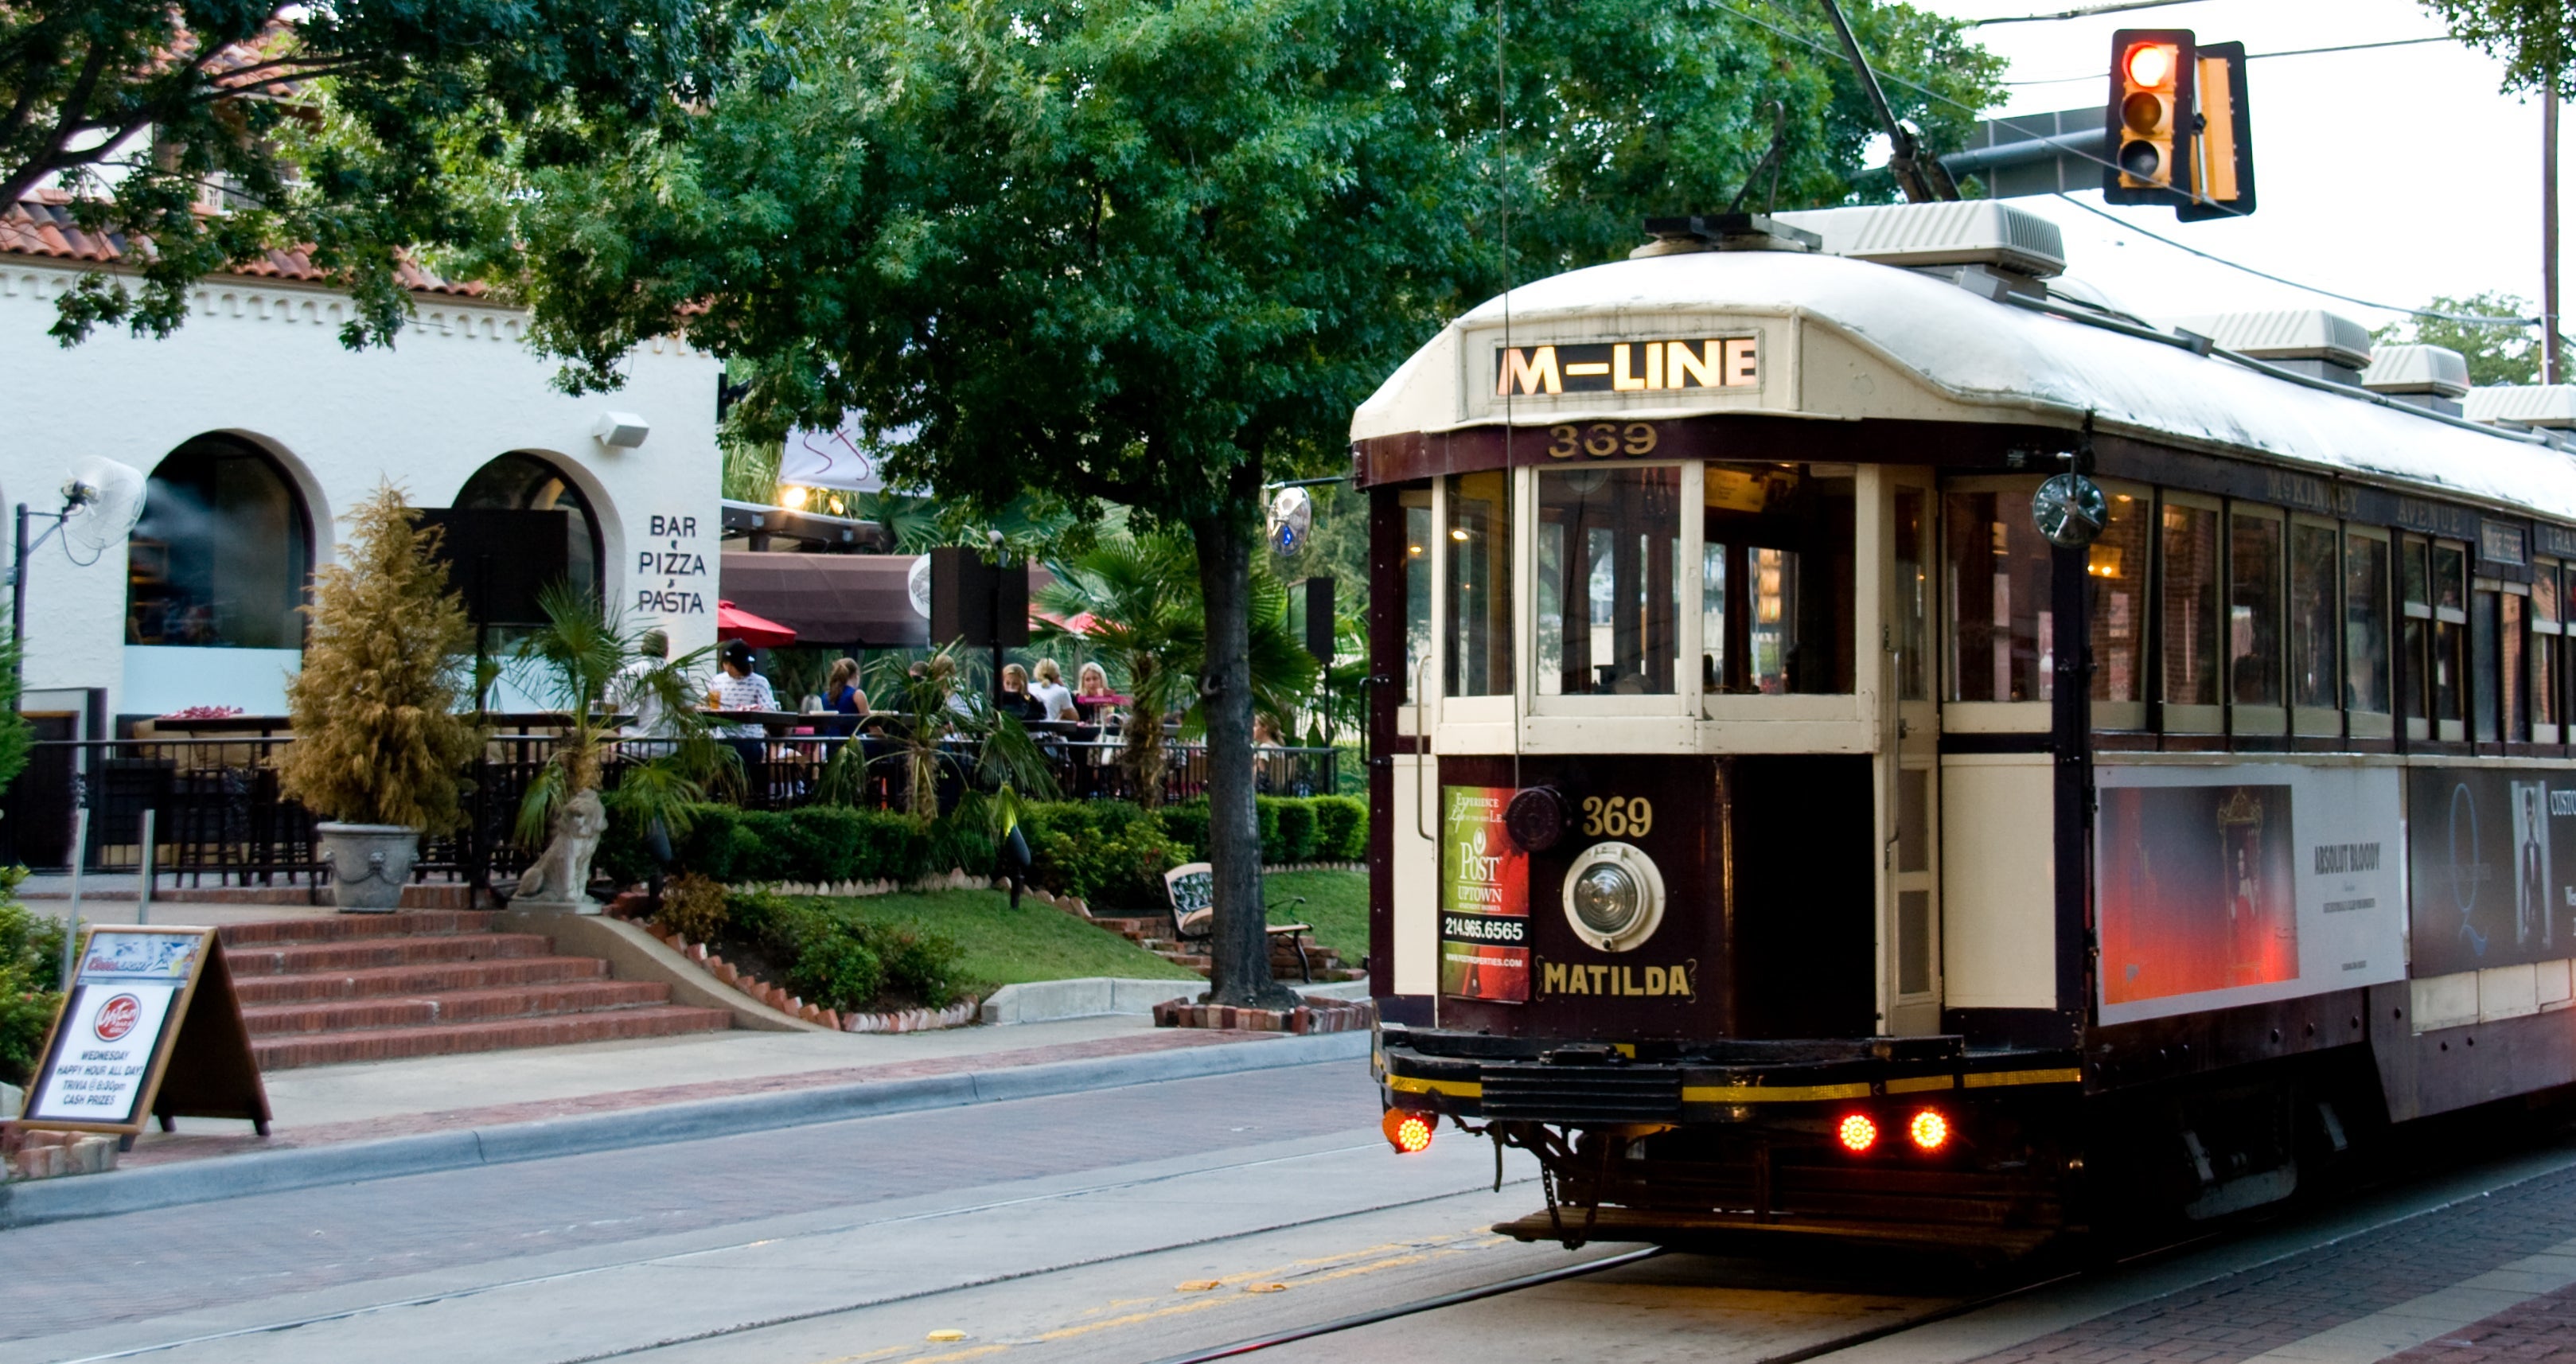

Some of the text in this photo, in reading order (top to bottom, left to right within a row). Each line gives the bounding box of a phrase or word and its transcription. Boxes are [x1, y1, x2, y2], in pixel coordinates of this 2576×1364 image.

[1548, 423, 1658, 458] 369
[650, 515, 696, 537] BAR
[2397, 497, 2461, 533] AVENUE
[638, 551, 706, 576] PIZZA
[638, 590, 704, 614] PASTA
[1582, 796, 1653, 837] 369
[2314, 845, 2348, 875] ABSOLUT
[2349, 842, 2380, 872] BLOODY
[1458, 885, 1502, 903] UPTOWN
[1444, 916, 1524, 941] 214.965.6565
[1544, 963, 1691, 996] MATILDA
[81, 1050, 131, 1060] WEDNESDAY
[57, 1066, 83, 1075] HAPPY
[84, 1066, 107, 1075] HOUR
[108, 1066, 122, 1076] ALL
[63, 1080, 88, 1090] TRIVIA
[63, 1095, 86, 1105] CASH
